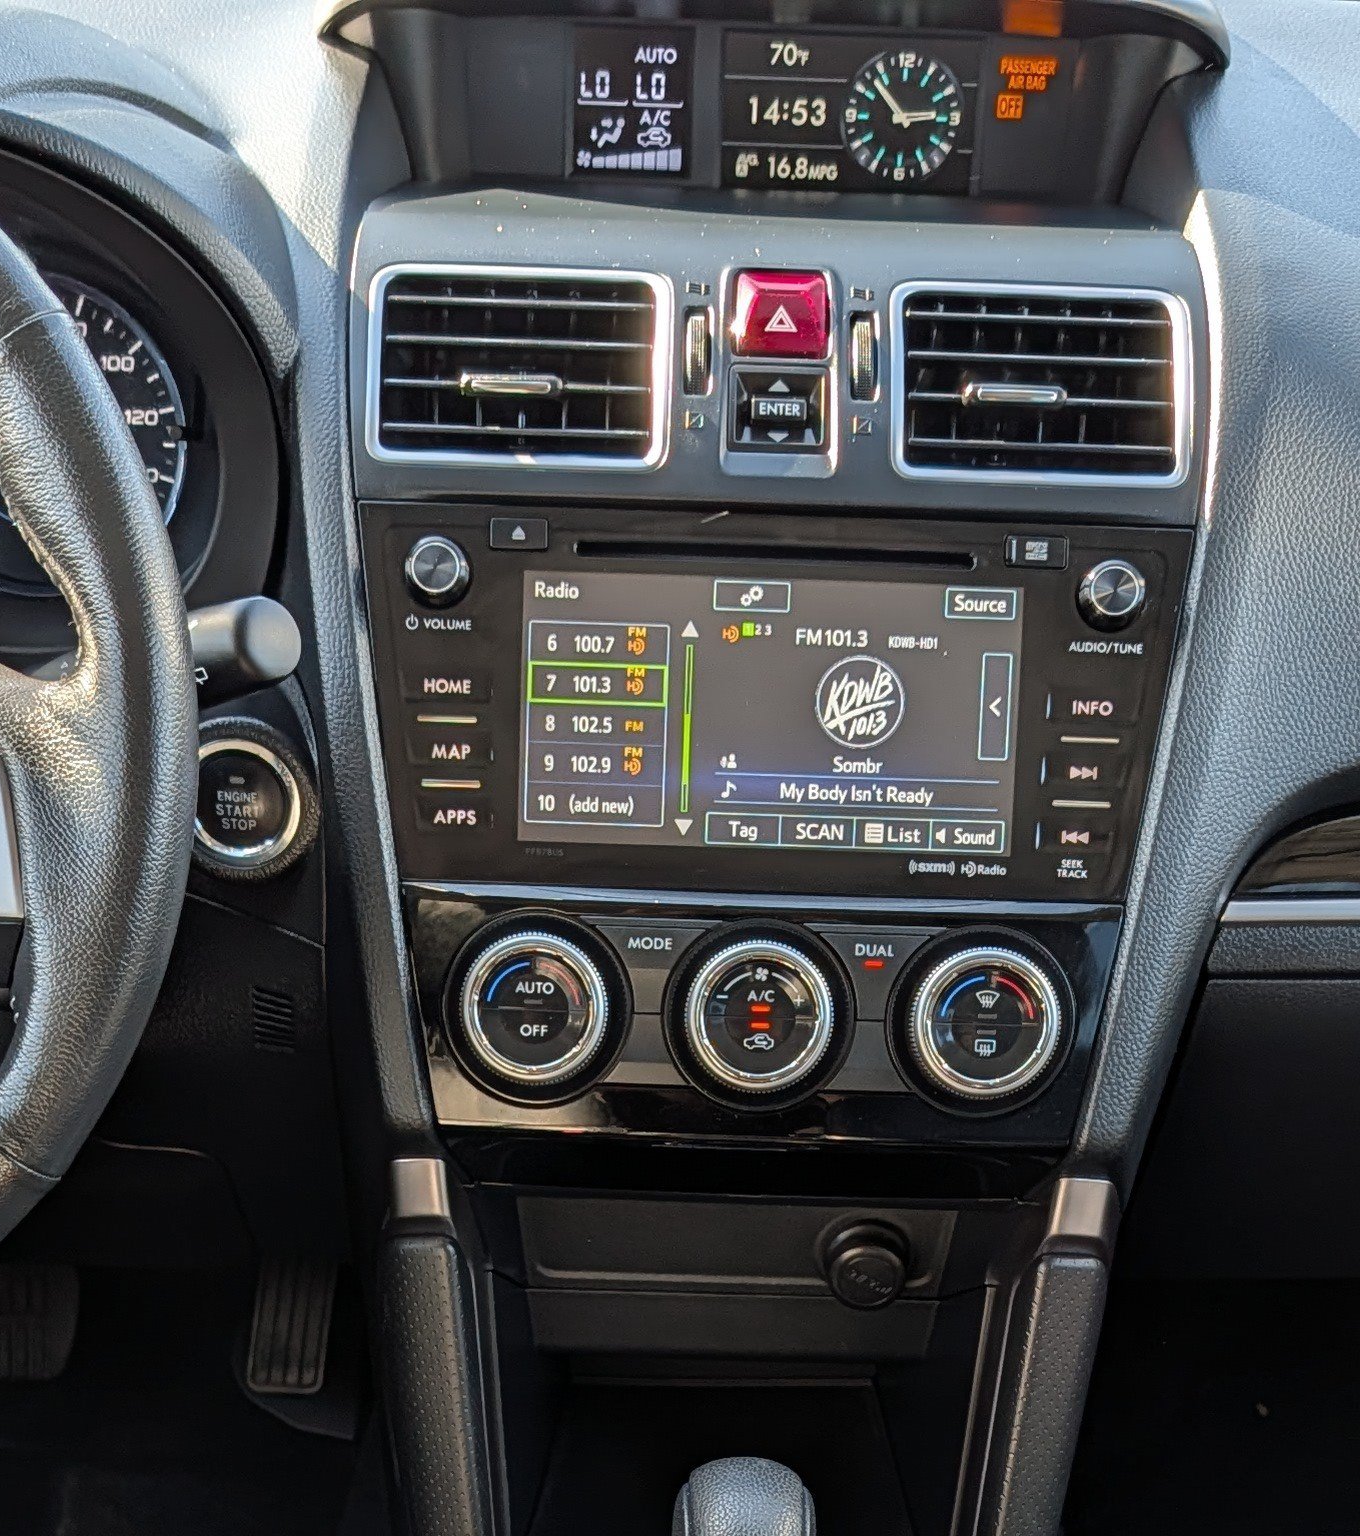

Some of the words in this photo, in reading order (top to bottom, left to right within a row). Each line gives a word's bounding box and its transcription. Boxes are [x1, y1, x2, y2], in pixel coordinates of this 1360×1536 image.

[634, 45, 678, 64] AUTO
[899, 51, 917, 69] 12
[1000, 56, 1057, 75] PASSENGER
[749, 97, 827, 127] 14:53
[845, 107, 858, 124] 9
[999, 97, 1022, 116] OFF
[639, 109, 671, 127] A/C
[948, 110, 961, 127] 3
[893, 167, 906, 181] 6
[124, 409, 159, 426] 120
[758, 402, 802, 417] ENTER
[534, 581, 580, 600] Radio
[954, 595, 1007, 615] Source
[423, 618, 472, 632] VOLUME
[627, 626, 647, 638] FM
[547, 635, 558, 653] 6
[573, 635, 615, 655] 100.7
[1068, 641, 1144, 656] AUDIO/TUNE
[626, 667, 646, 678] FM
[423, 677, 472, 695] HOME
[545, 674, 557, 693] 7
[572, 675, 612, 695] 101.3
[824, 664, 895, 736] KDWB
[1071, 699, 1114, 717] INFO
[544, 714, 556, 732] 8
[571, 715, 613, 735] 102.5
[624, 720, 644, 733] FM
[431, 744, 472, 761] MAP
[623, 746, 643, 758] FM
[543, 754, 555, 772] 9
[570, 755, 612, 775] 102.9
[832, 756, 883, 775] Sombr
[217, 790, 258, 804] ENGINE
[780, 782, 806, 803] My
[807, 784, 848, 804] Body
[850, 784, 884, 804] Isn't
[886, 787, 935, 807] Ready
[215, 803, 259, 818] START
[537, 794, 556, 813] 10
[568, 794, 600, 814] (add
[601, 796, 634, 817] new)
[221, 817, 258, 831] STOP
[433, 809, 478, 827] APPS
[727, 820, 759, 842] Tag
[795, 824, 845, 842] SCAN
[887, 826, 922, 845] List
[953, 828, 996, 846] Sound
[978, 863, 1008, 876] Radio
[1060, 859, 1083, 869] SEEK
[1056, 868, 1088, 879] TRACK
[627, 936, 674, 950] MODE
[854, 943, 895, 957] DUAL
[515, 981, 555, 995] AUTO
[747, 989, 776, 1003] A/C
[519, 1024, 548, 1037] OFF
